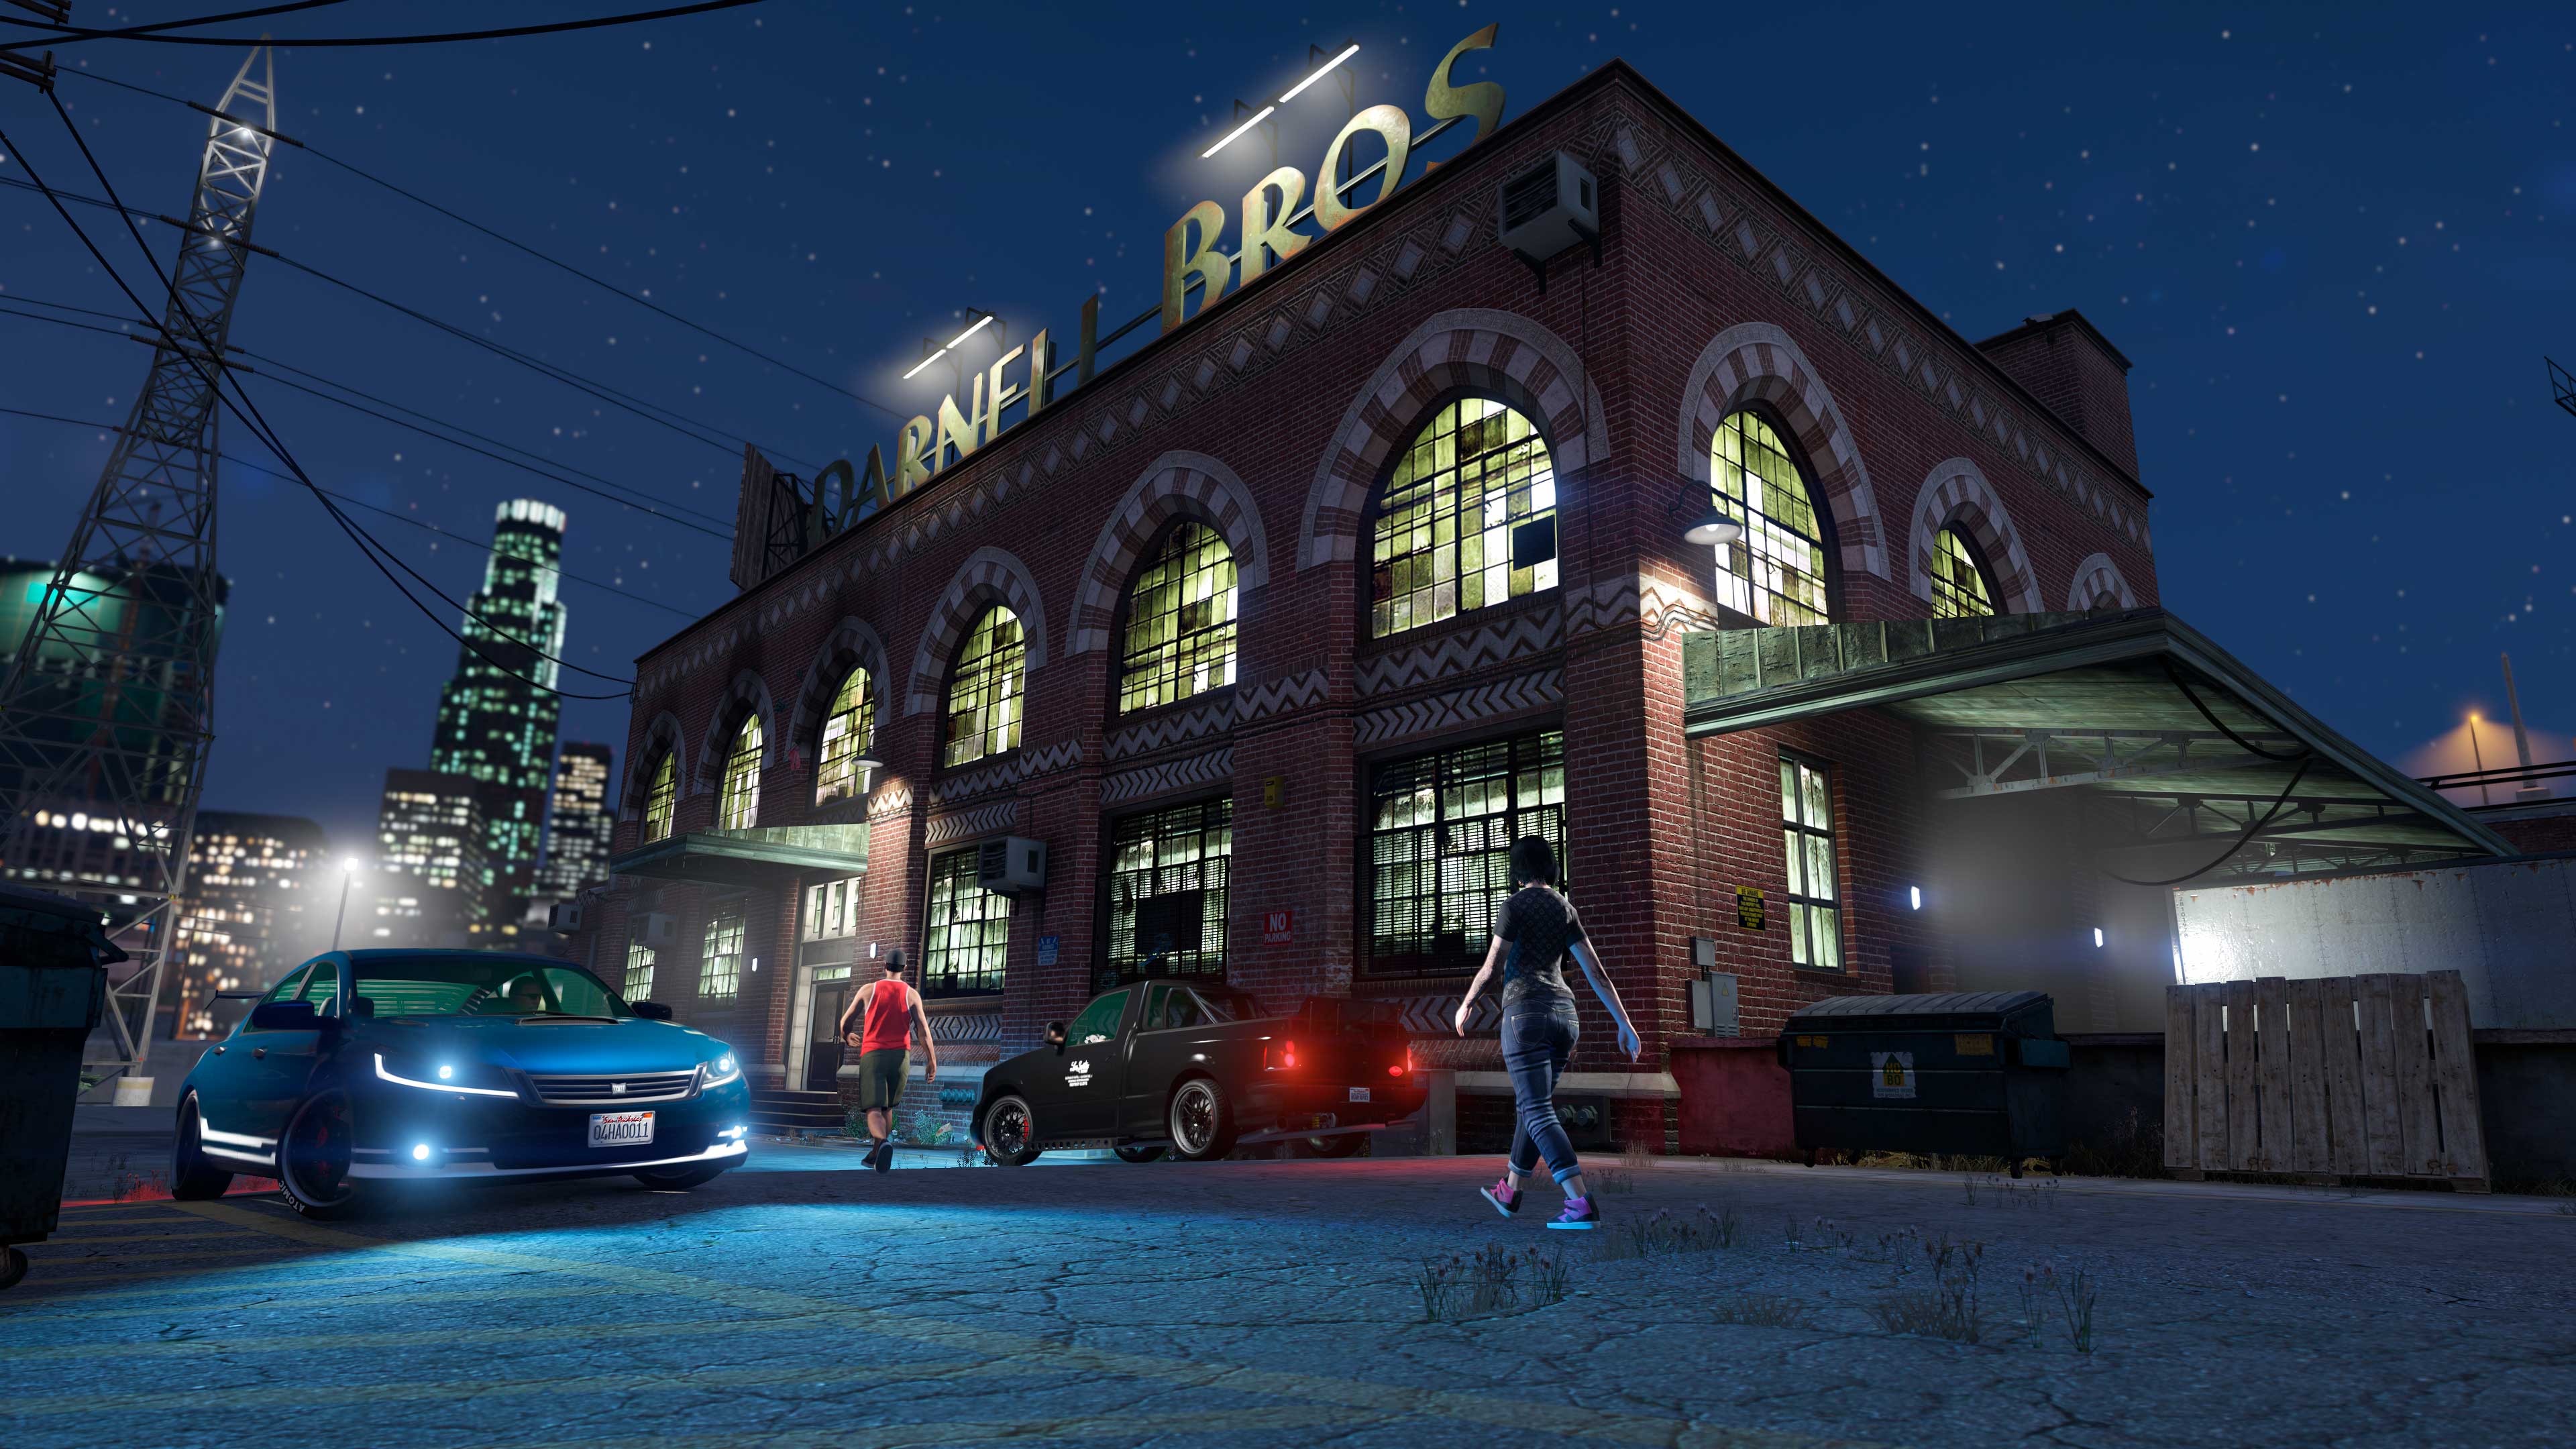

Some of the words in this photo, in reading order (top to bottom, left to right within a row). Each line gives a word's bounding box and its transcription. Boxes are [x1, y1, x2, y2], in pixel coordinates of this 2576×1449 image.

[1162, 22, 1505, 333] BROS
[1269, 912, 1287, 932] NO
[1265, 930, 1291, 944] PARKING
[1886, 1062, 1900, 1073] HO
[1888, 1074, 1900, 1085] BO
[602, 1116, 615, 1124] San
[278, 1180, 306, 1213] ATOMIC
